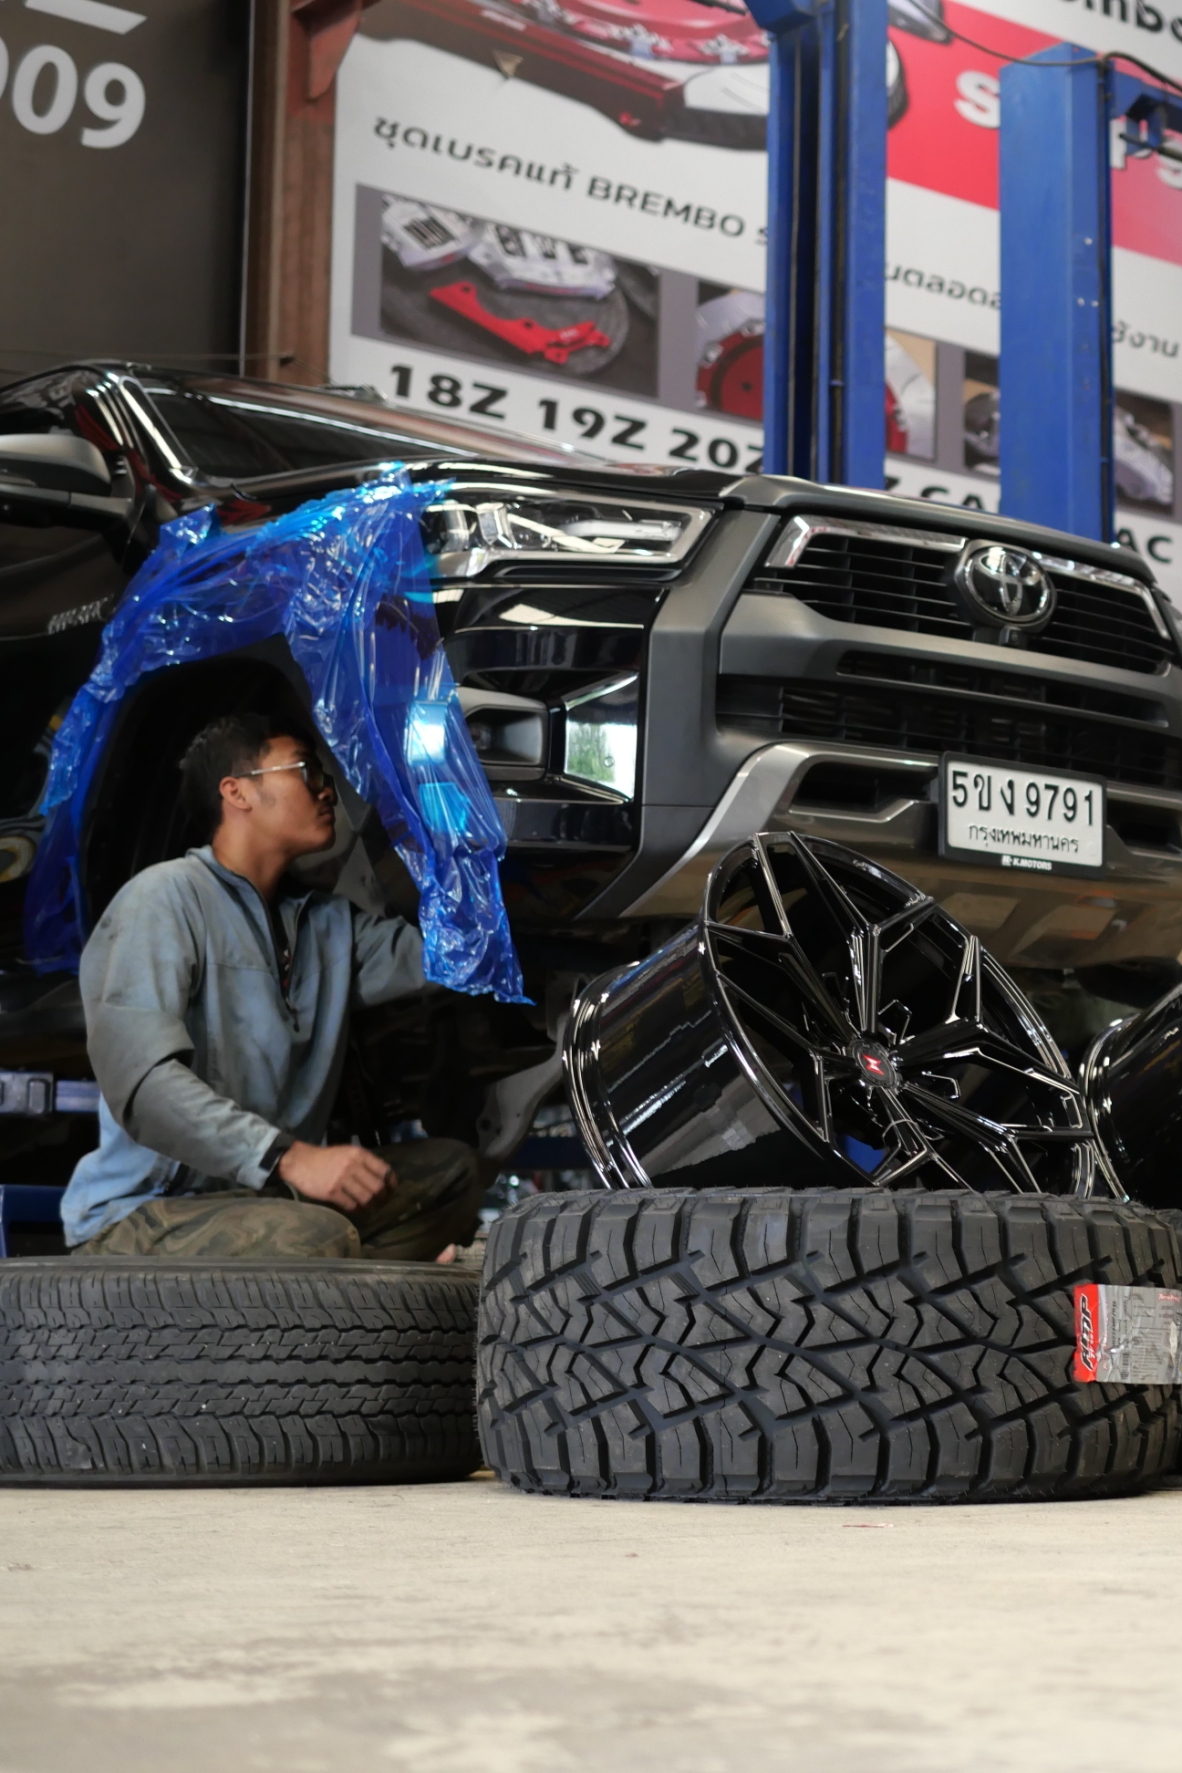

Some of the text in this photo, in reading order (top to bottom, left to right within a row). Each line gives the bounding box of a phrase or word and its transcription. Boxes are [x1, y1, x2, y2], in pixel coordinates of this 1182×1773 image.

[0, 36, 146, 148] 09
[587, 176, 745, 239] BREMBO
[391, 364, 509, 420] 18Z
[538, 399, 648, 452] 19Z
[1025, 782, 1094, 826] 9791
[969, 824, 1079, 854] กรุงเทพมหานคร
